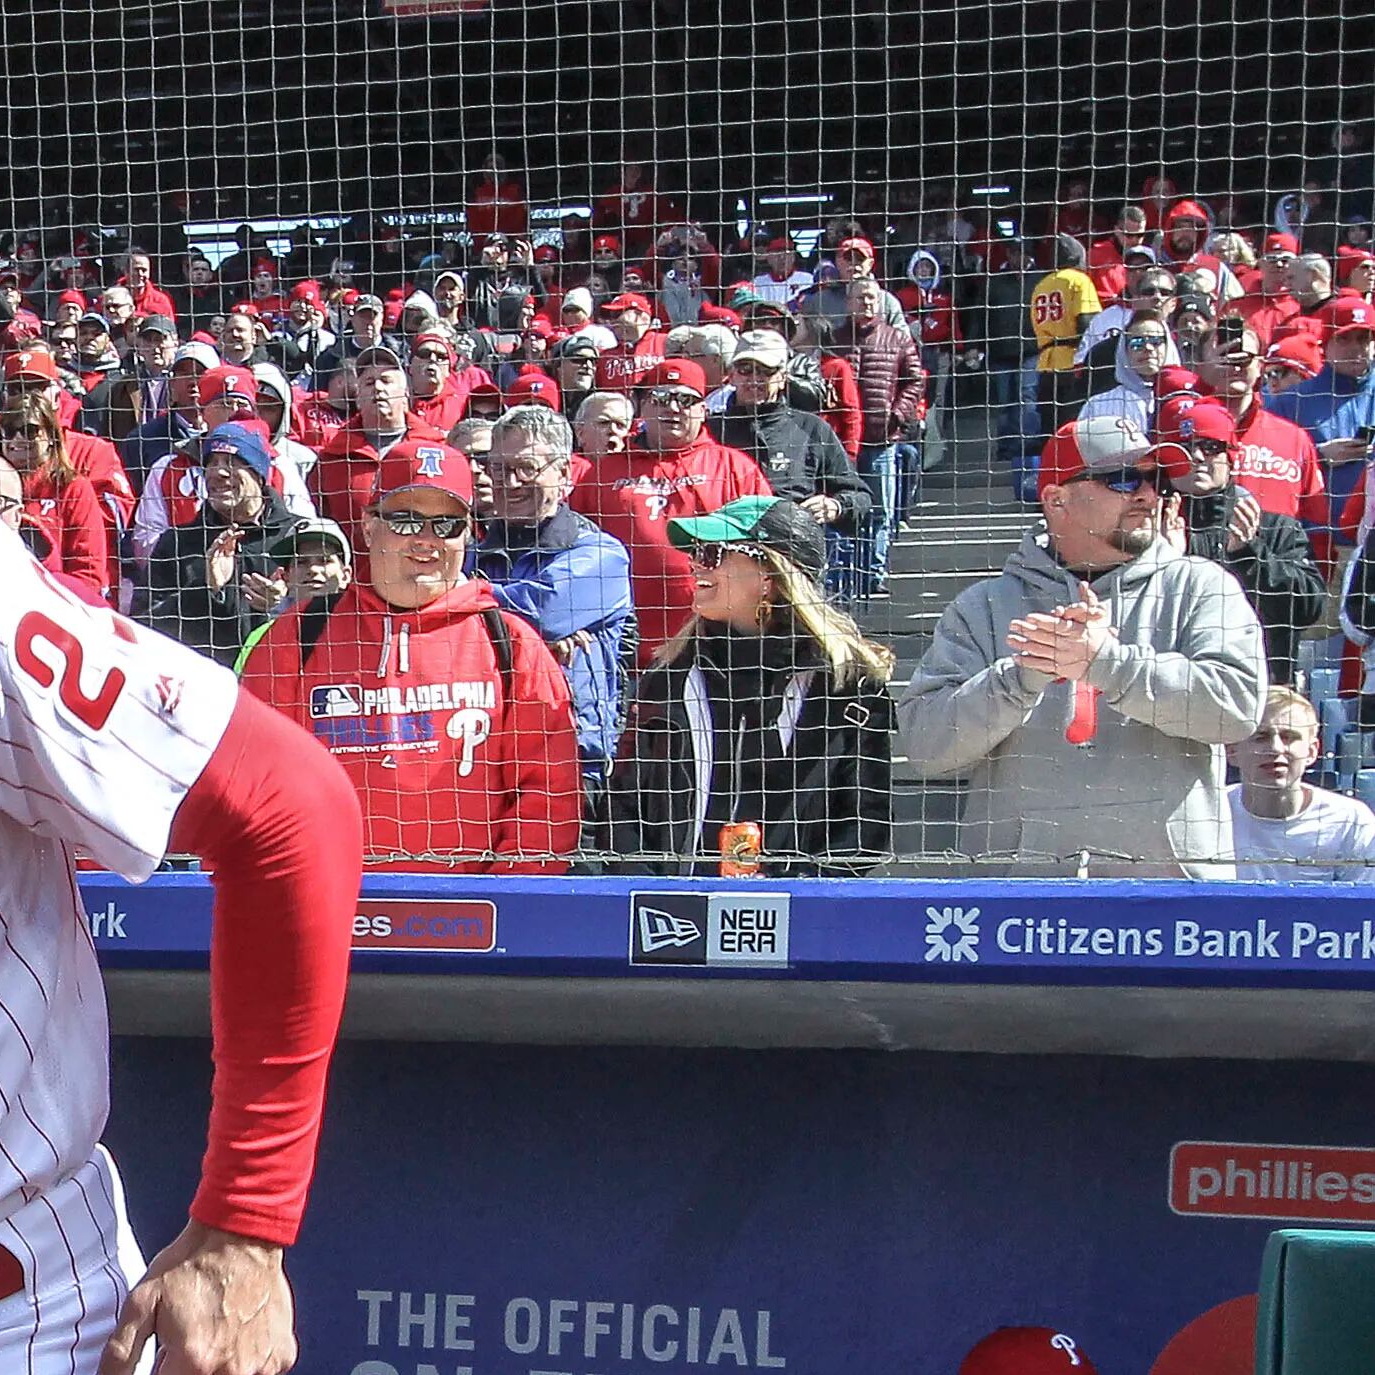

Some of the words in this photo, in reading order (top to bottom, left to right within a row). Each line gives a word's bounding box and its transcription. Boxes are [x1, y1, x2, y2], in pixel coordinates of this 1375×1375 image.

[645, 495, 668, 521] P
[14, 608, 139, 731] 2
[363, 681, 496, 716] PHILADELPHIA
[446, 707, 492, 777] P
[93, 902, 128, 938] rk
[720, 909, 777, 931] NEW
[720, 931, 777, 953] ERA
[996, 917, 1164, 956] Citizens
[1173, 918, 1281, 958] Bank
[1291, 920, 1375, 959] Park
[356, 1289, 476, 1351] THE
[503, 1297, 787, 1368] OFFICIAL
[1051, 1334, 1080, 1366] P
